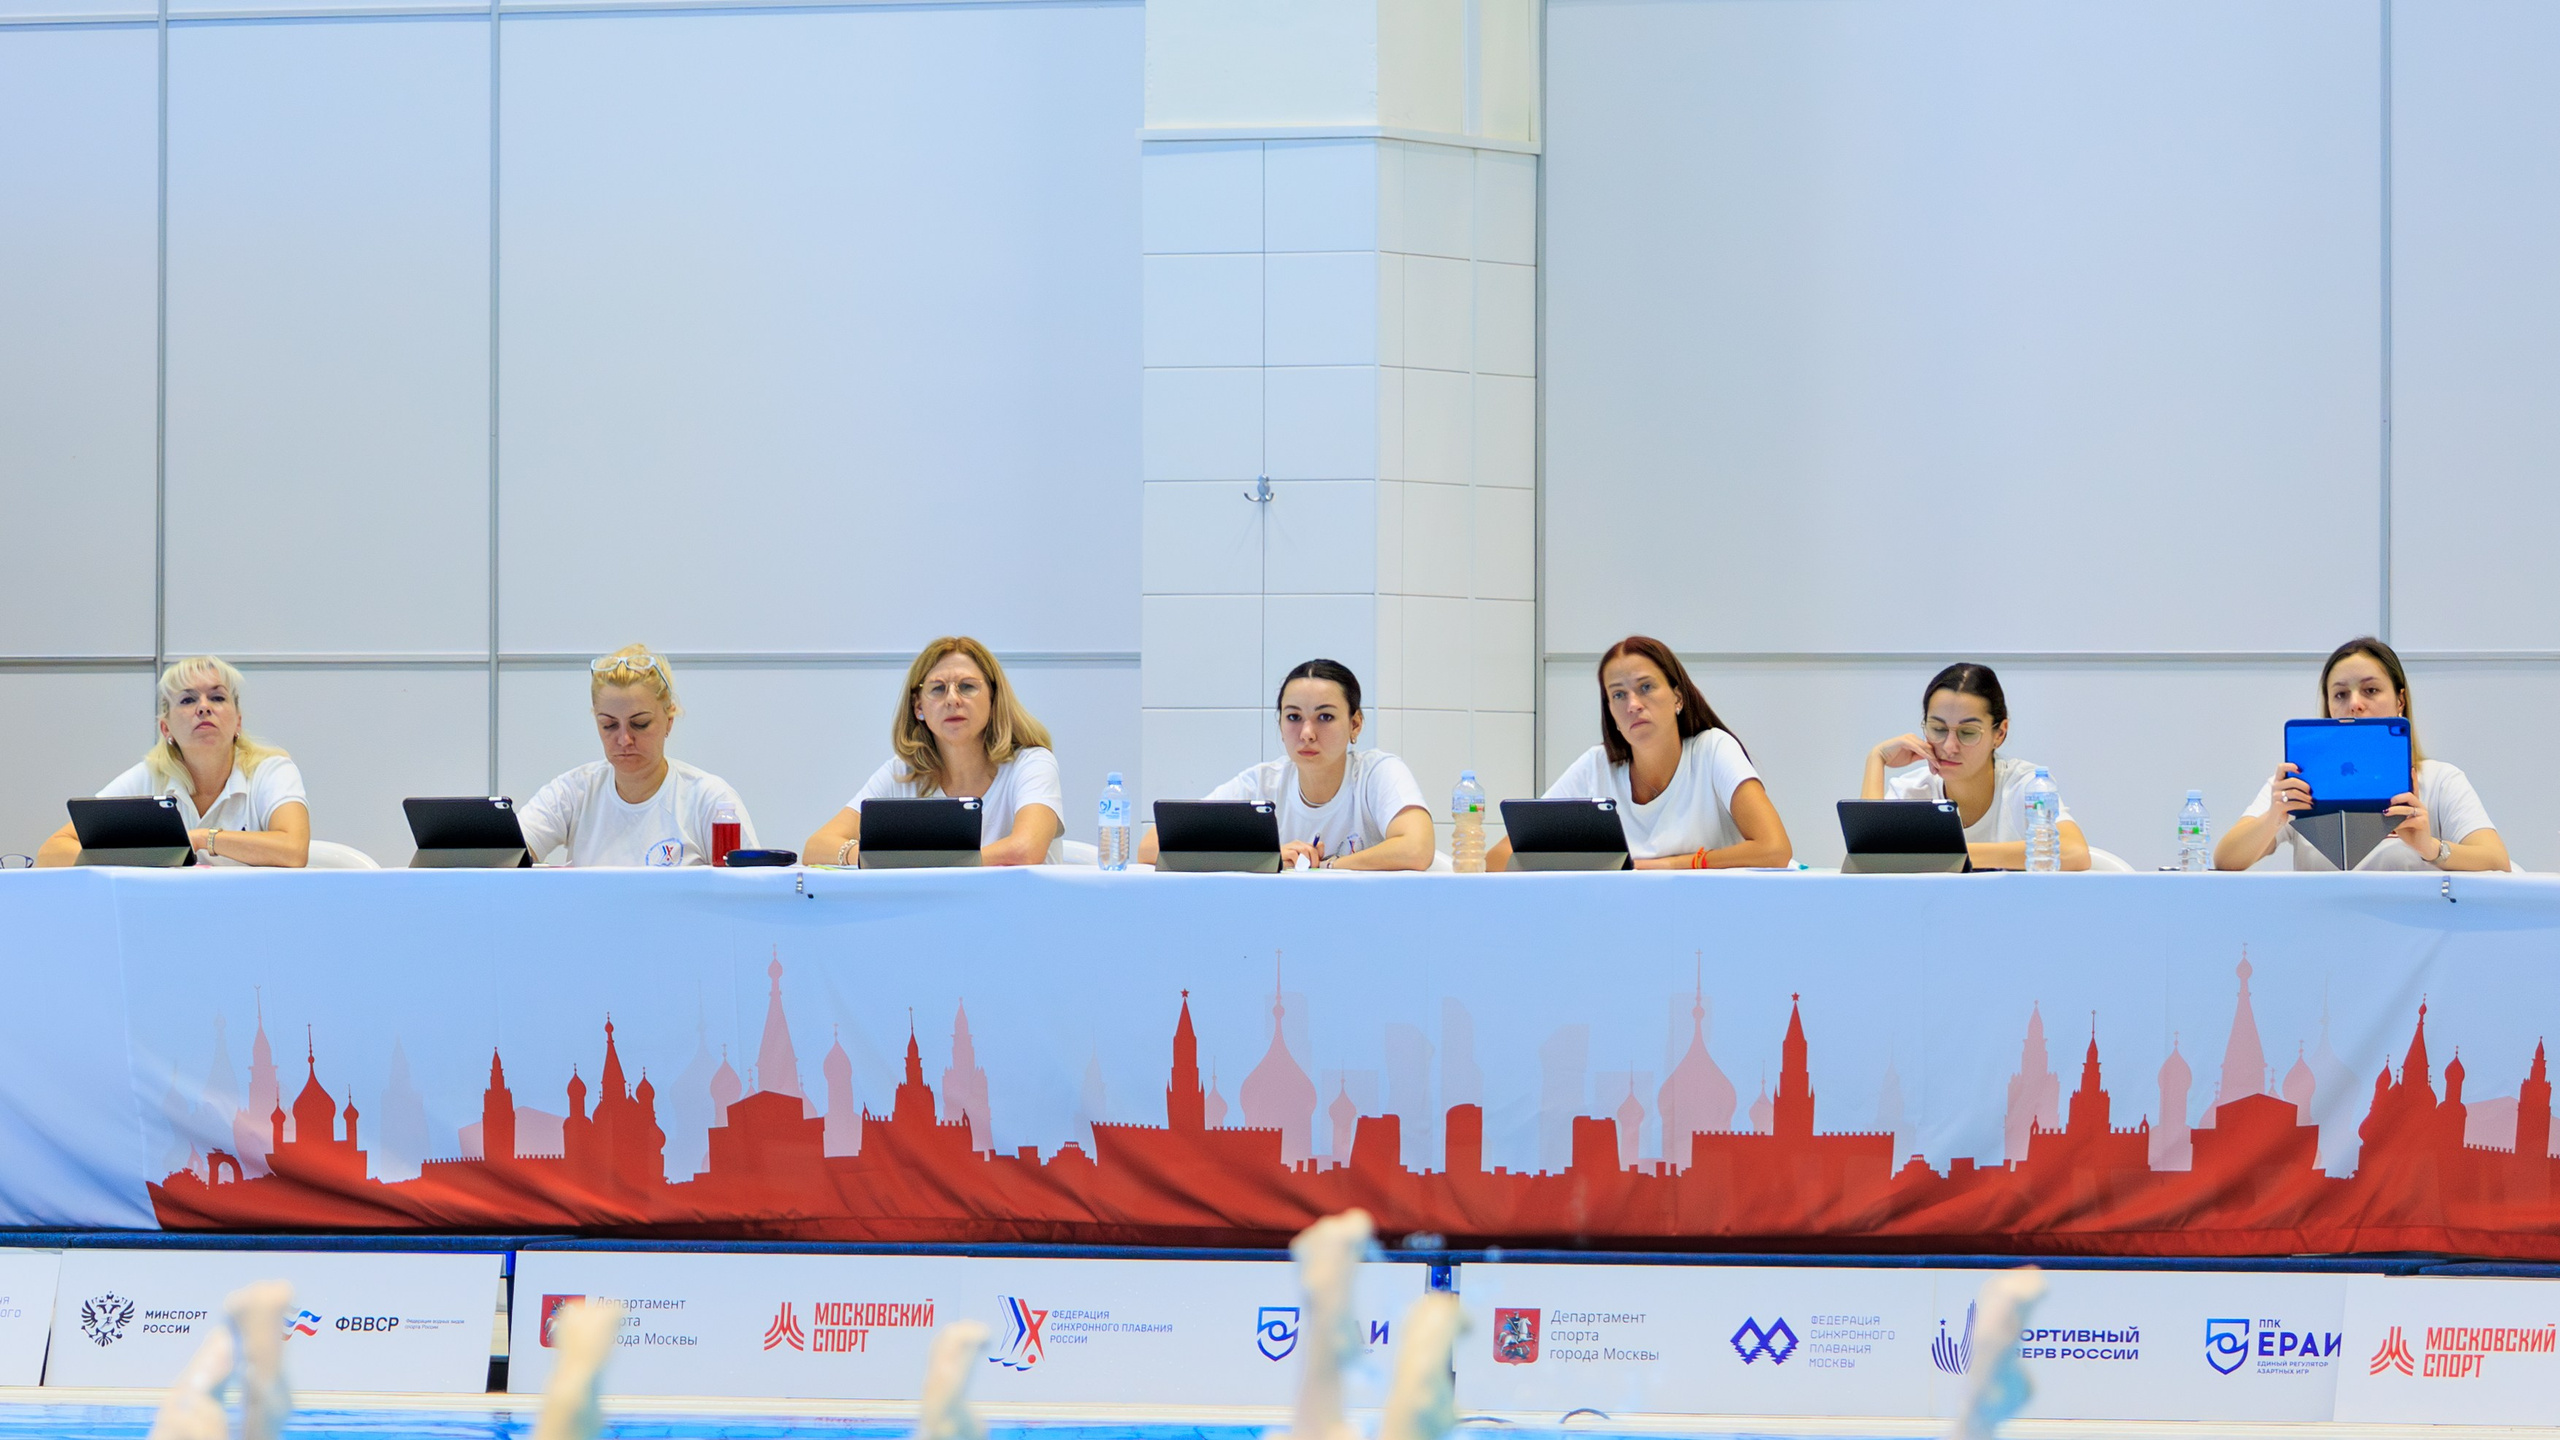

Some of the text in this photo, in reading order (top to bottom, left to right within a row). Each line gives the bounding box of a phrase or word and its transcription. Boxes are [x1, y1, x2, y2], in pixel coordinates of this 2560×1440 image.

[144, 1310, 208, 1320] МИНСПОРТ
[814, 1298, 934, 1328] МОСКОВСКИЙ
[1051, 1310, 1110, 1320] ФЕДЕРАЦИЯ
[1551, 1309, 1647, 1326] Департамент
[335, 1316, 399, 1332] ФВВСР
[1811, 1315, 1881, 1326] ФЕДЕРАЦИЯ
[2258, 1319, 2281, 1328] ППК
[142, 1324, 191, 1334] РОССИИ
[1050, 1322, 1173, 1333] СИНХРОННОГО ПЛАВАНИЯ
[644, 1333, 698, 1346] Москвы
[1050, 1335, 1088, 1344] РОССИИ
[1550, 1328, 1599, 1345] спорта
[1810, 1329, 1896, 1340] СИНХРОННОГО
[2019, 1325, 2140, 1343] ОРТИВНЫЙ
[2425, 1323, 2556, 1353] МОСКОВСКИЙ
[812, 1328, 869, 1353] СПОРТ
[2258, 1331, 2342, 1357] ЕРАИ
[1809, 1343, 1872, 1354] ПЛАВАНИЯ
[2060, 1348, 2139, 1360] РОССИИ
[1549, 1347, 1660, 1363] города Москвы
[1809, 1358, 1856, 1368] МОСКВЫ
[2422, 1353, 2485, 1378] СПОРТ
